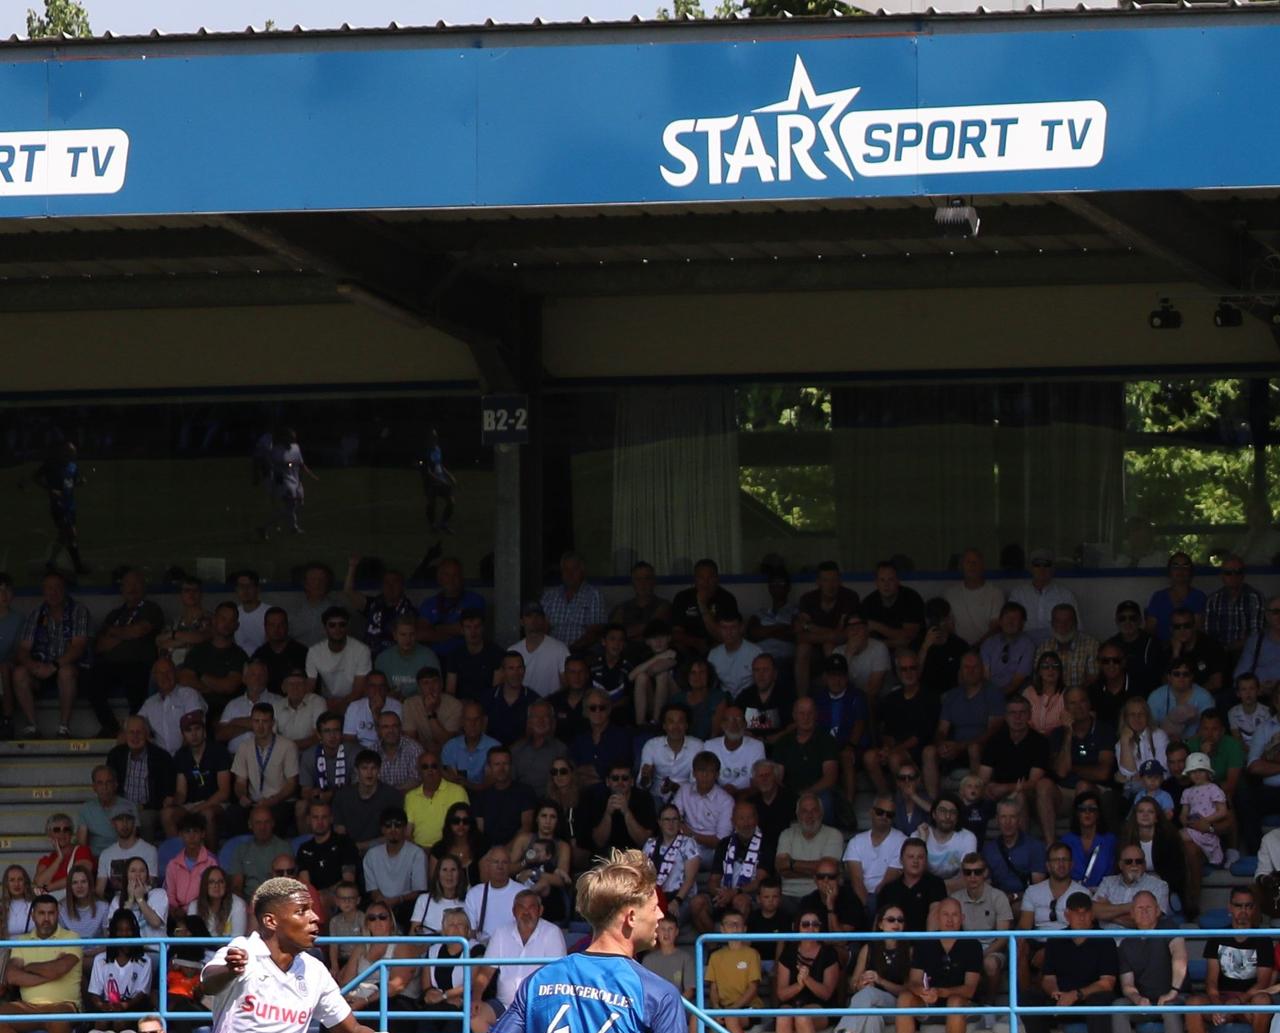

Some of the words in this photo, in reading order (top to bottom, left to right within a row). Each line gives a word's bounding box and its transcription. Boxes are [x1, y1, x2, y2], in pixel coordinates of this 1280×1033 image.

[67, 145, 115, 178] TV
[660, 113, 828, 188] STAR
[862, 117, 1019, 164] SPORT
[1041, 117, 1093, 152] TV
[483, 408, 528, 431] B2-2
[538, 984, 554, 996] DE
